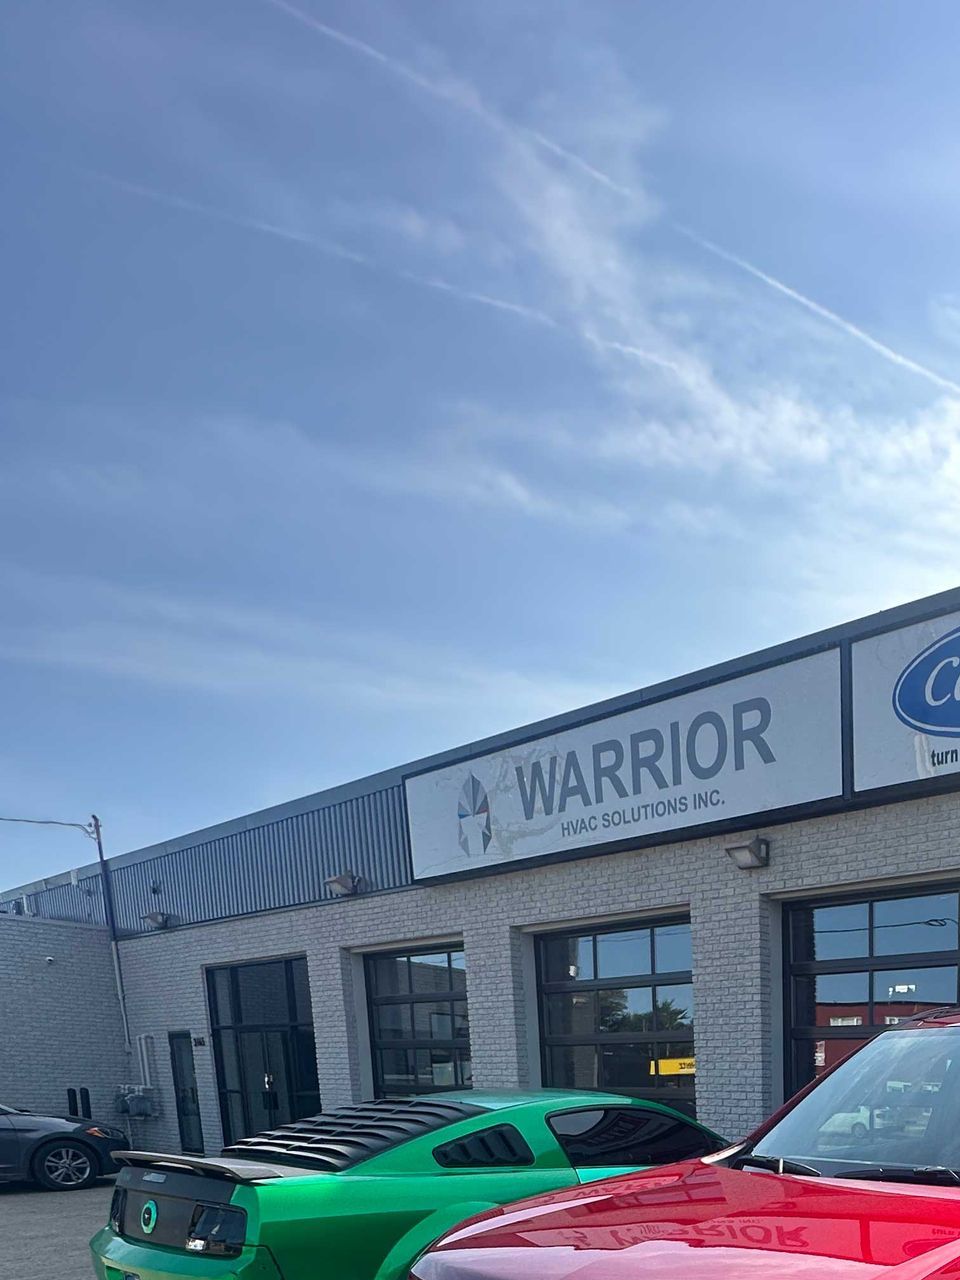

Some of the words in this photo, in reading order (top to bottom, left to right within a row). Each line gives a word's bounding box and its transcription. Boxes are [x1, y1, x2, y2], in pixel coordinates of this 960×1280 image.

[514, 697, 777, 821] WARRIOR
[931, 748, 958, 767] turn
[561, 816, 598, 838] HVAC
[601, 796, 689, 829] SOLUTIONS
[692, 789, 726, 808] INC.
